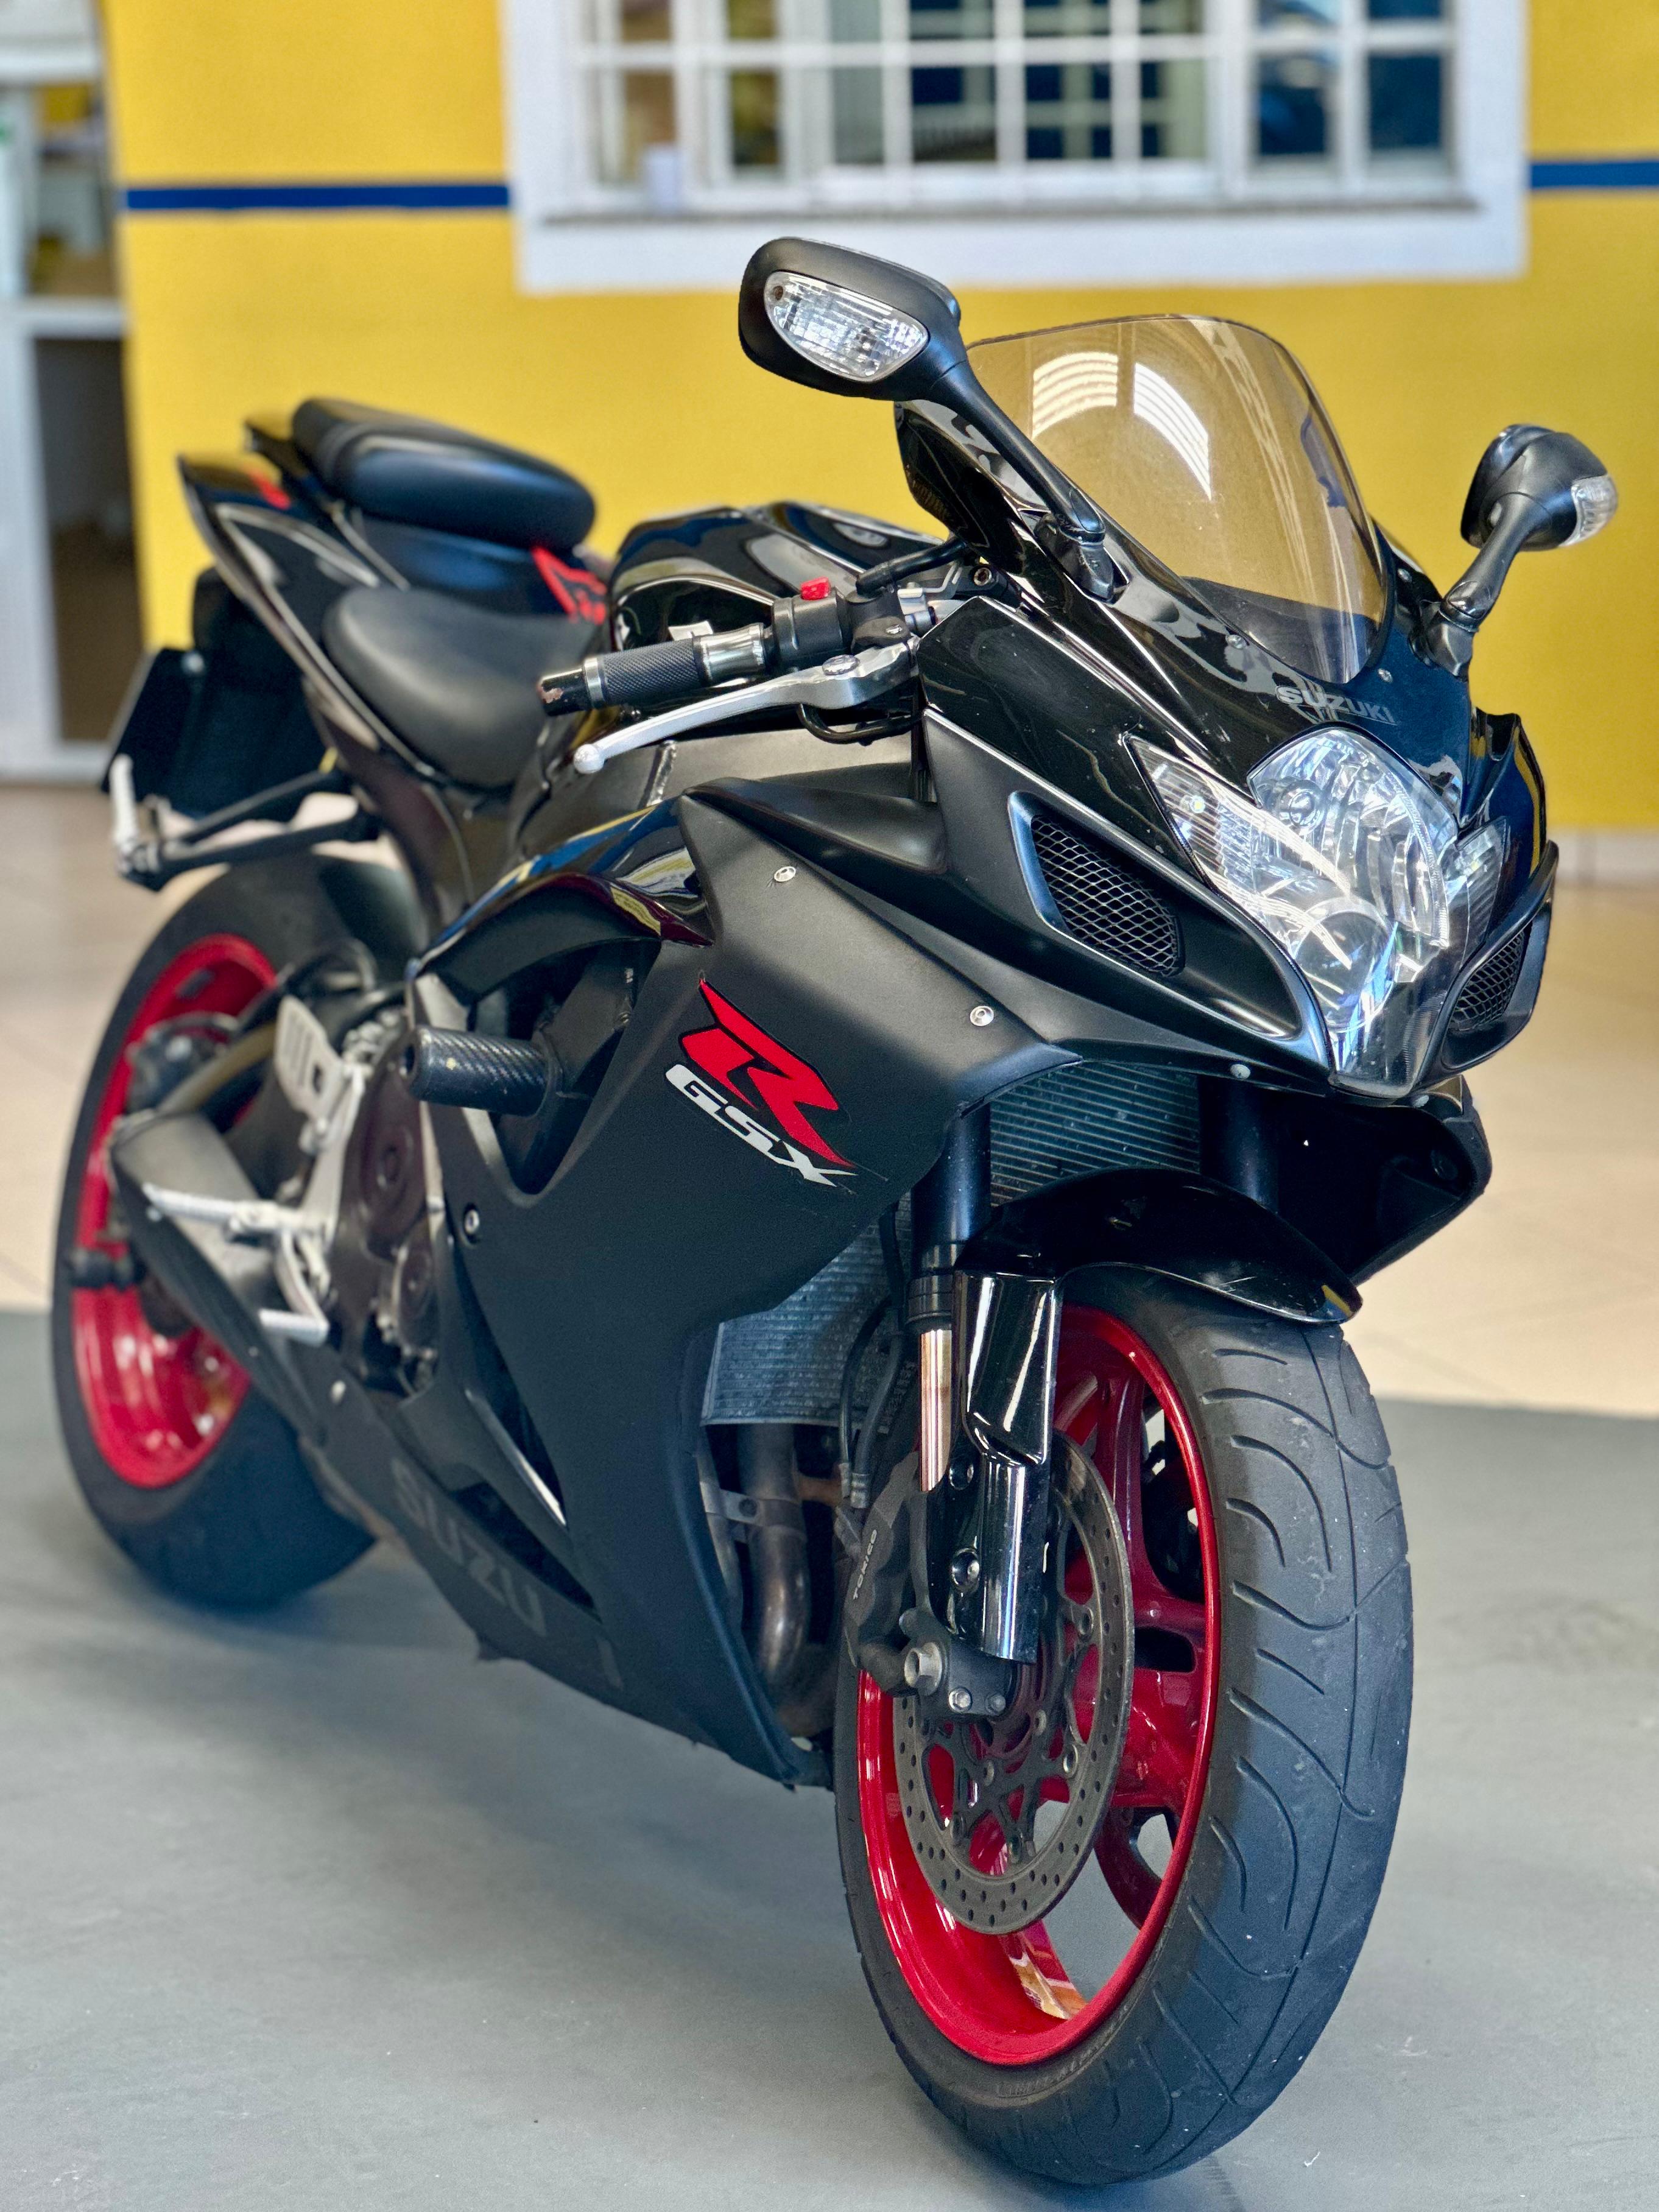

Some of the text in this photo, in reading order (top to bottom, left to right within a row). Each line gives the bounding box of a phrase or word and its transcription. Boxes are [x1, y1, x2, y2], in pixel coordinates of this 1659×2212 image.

[1275, 685, 1397, 725] SUZUKI
[665, 1063, 858, 1187] GSX
[853, 1529, 878, 1600] TOKICO
